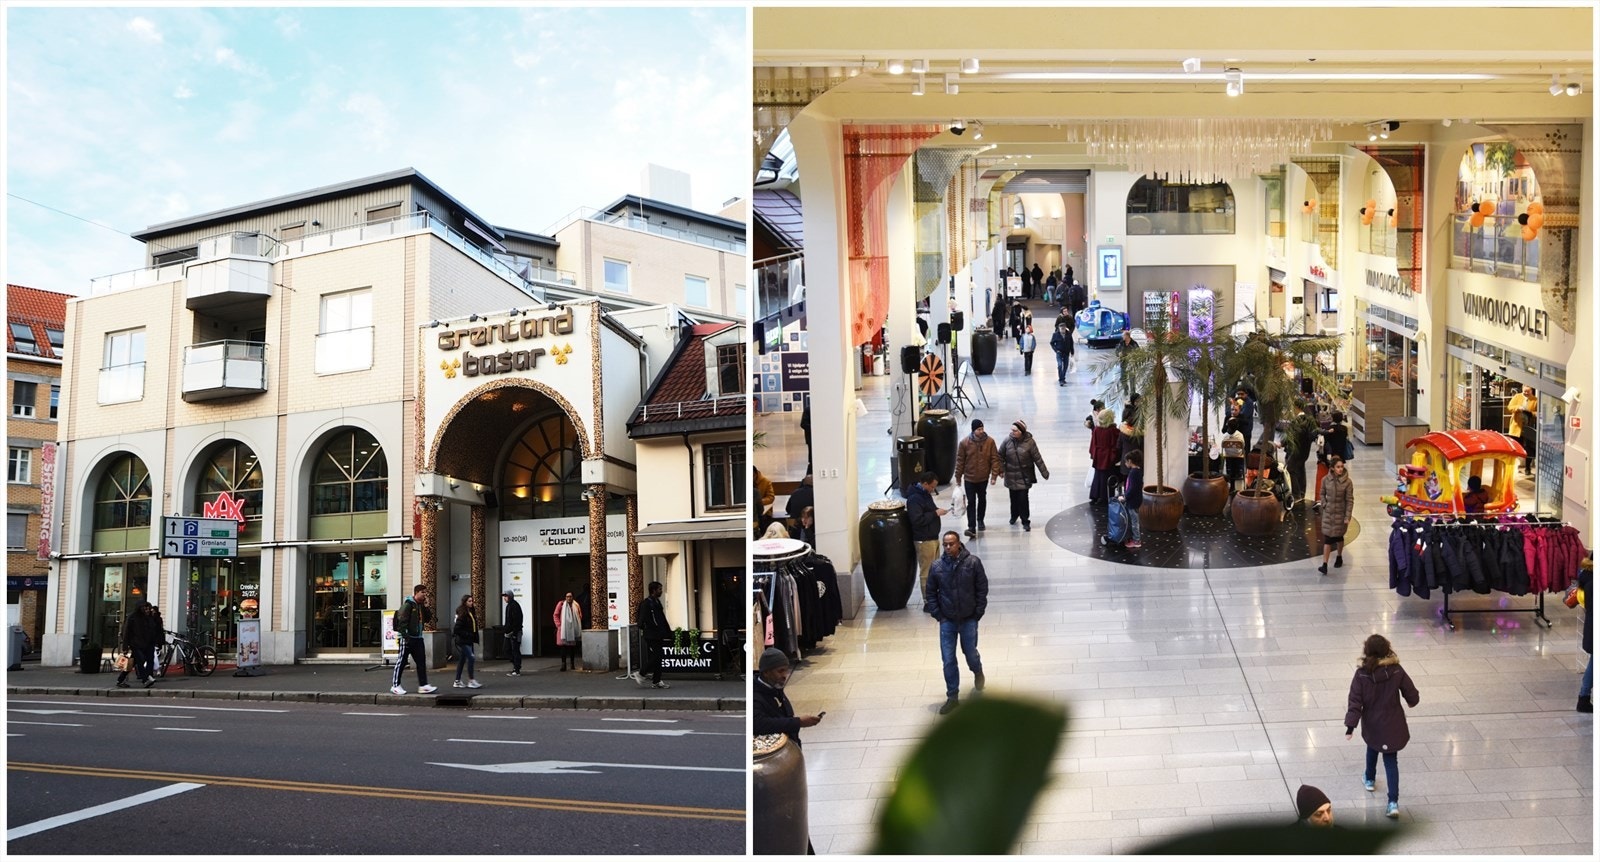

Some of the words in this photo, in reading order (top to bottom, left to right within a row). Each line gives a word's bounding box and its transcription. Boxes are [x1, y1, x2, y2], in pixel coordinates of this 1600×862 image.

[438, 306, 573, 350] Grønland
[1462, 291, 1549, 337] VINMONOPOLET
[462, 348, 546, 377] basar
[42, 463, 54, 540] SHOPPING
[203, 491, 245, 522] MAX
[503, 535, 528, 543] 10-20(18)
[606, 530, 625, 538] 20(18)
[661, 658, 712, 667] ESTAURANT
[662, 646, 701, 655] TYKIK
